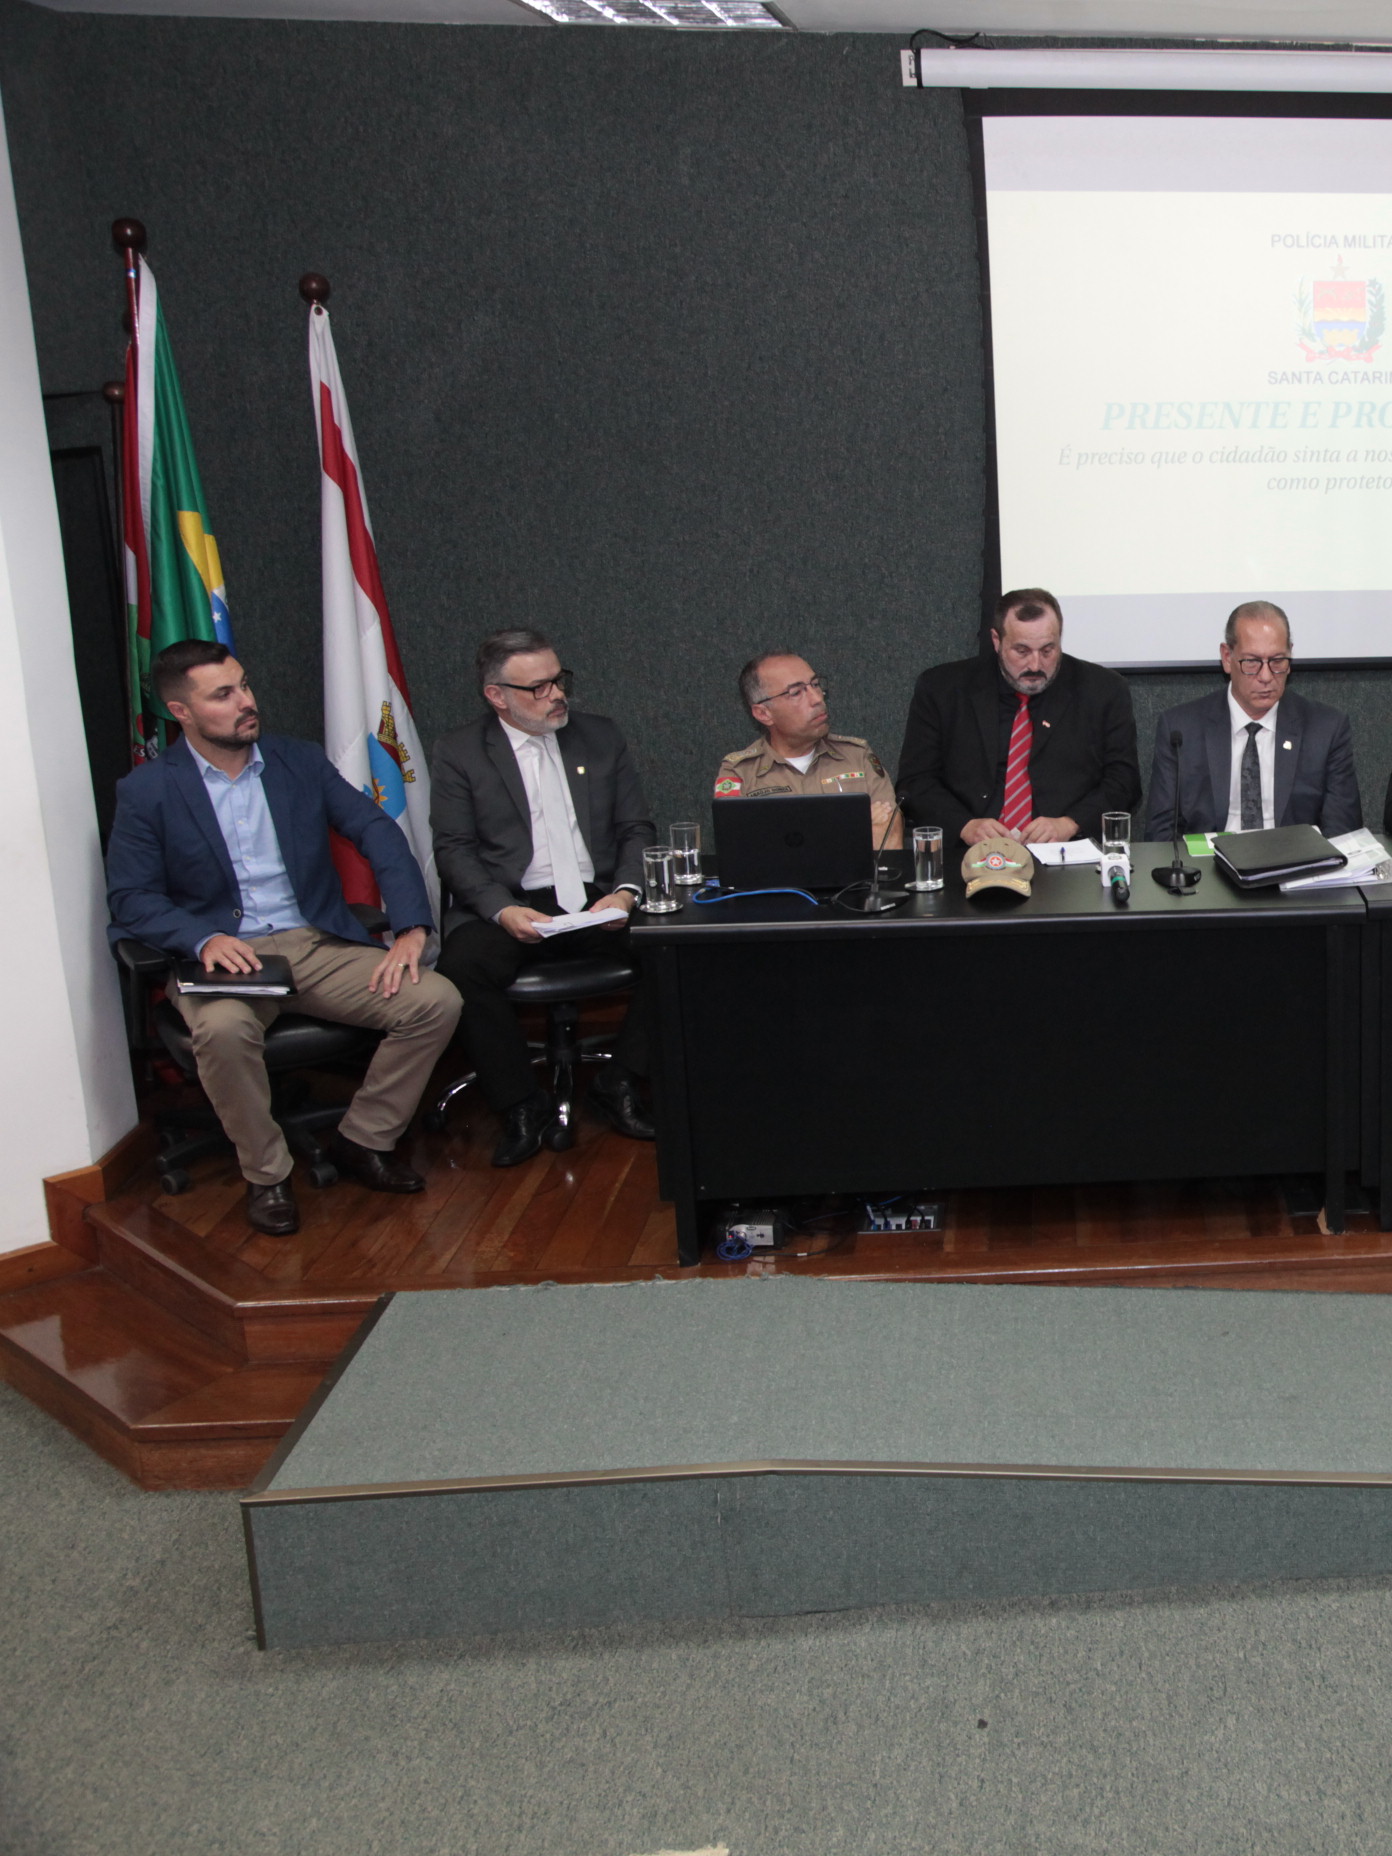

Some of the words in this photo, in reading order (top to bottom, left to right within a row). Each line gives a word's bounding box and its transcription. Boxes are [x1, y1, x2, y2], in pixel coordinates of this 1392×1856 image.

[1271, 231, 1339, 248] POLÍCIA
[1268, 371, 1323, 385] SANTA
[1099, 401, 1291, 430] PRESENTE
[1297, 401, 1322, 428] E
[1059, 444, 1071, 465] É
[1076, 447, 1145, 470] preciso
[1151, 451, 1187, 469] que
[1192, 451, 1204, 463] o
[1209, 445, 1287, 464] cidadão
[1293, 446, 1342, 463] sinta
[1346, 450, 1358, 462] a
[1267, 477, 1320, 490] como
